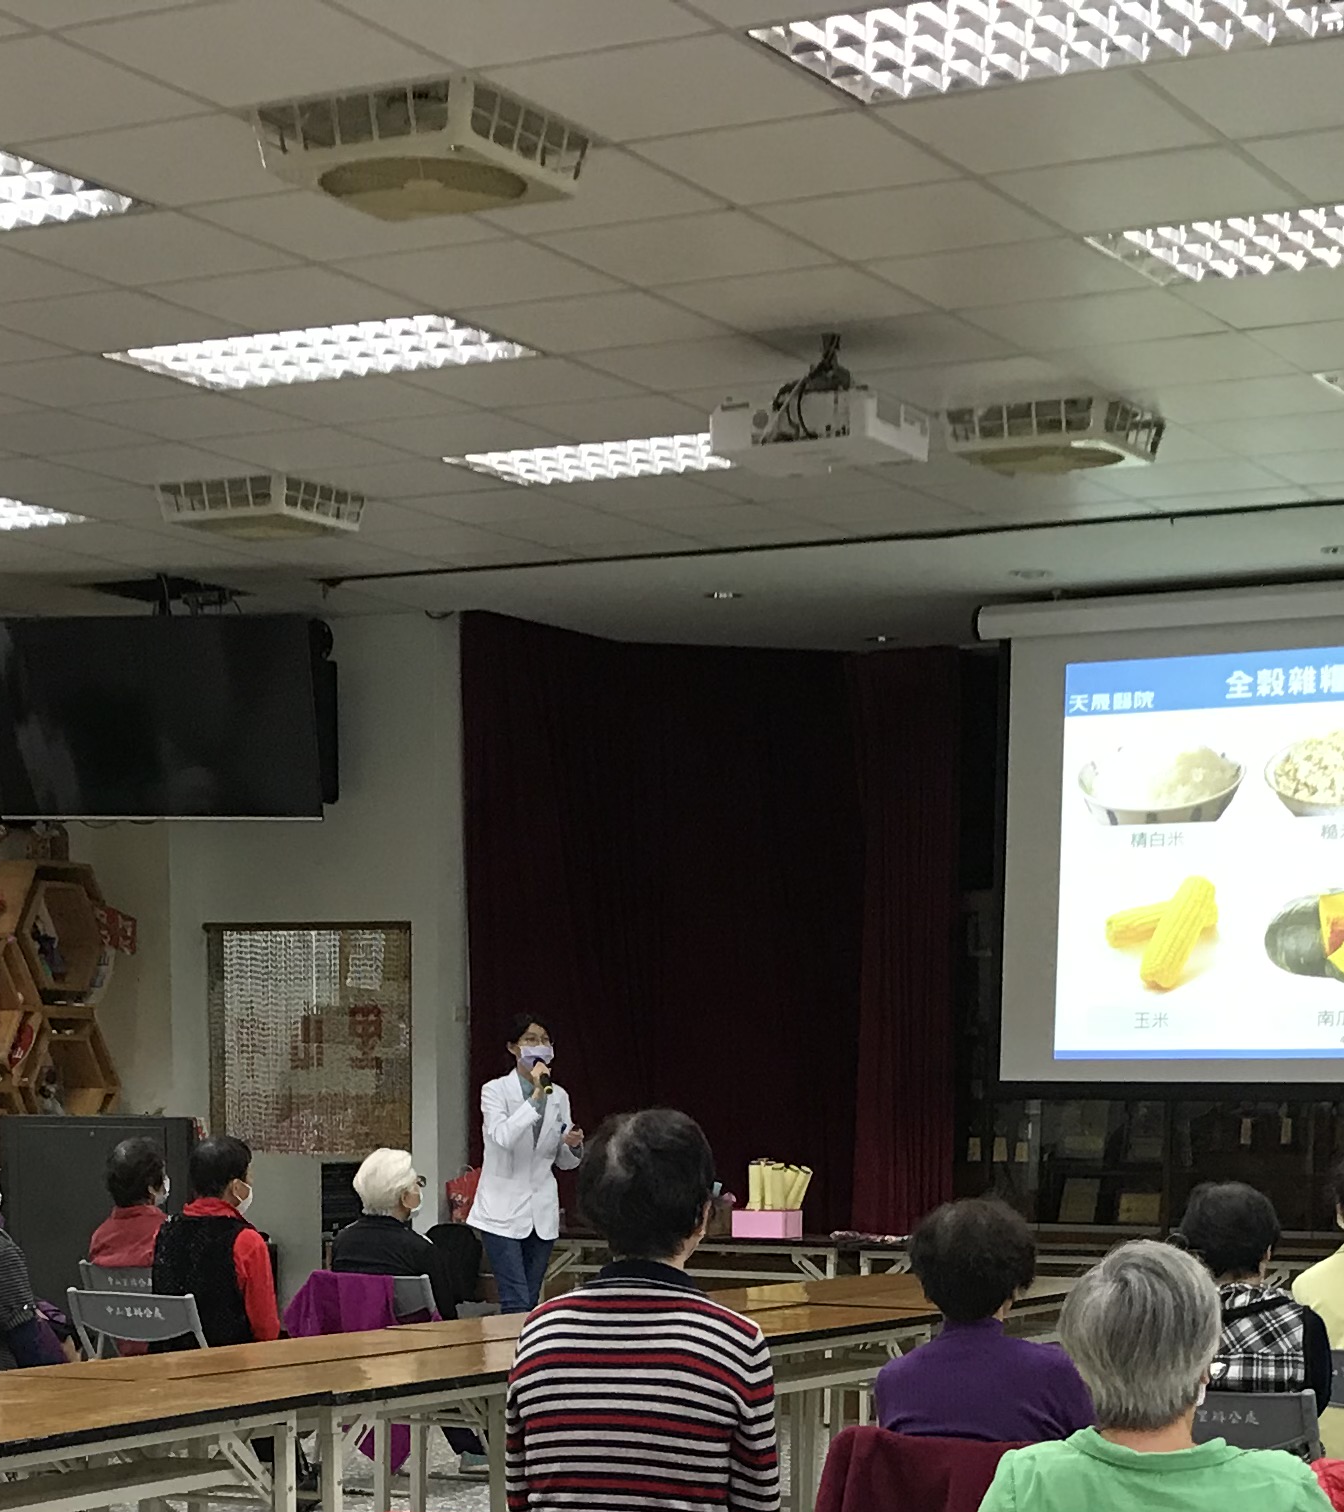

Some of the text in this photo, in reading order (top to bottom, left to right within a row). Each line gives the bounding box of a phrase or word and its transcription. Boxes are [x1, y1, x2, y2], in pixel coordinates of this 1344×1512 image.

[1068, 691, 1155, 713] 天晟醫院
[1130, 832, 1185, 848] 精白米
[1134, 1012, 1169, 1029] 玉米
